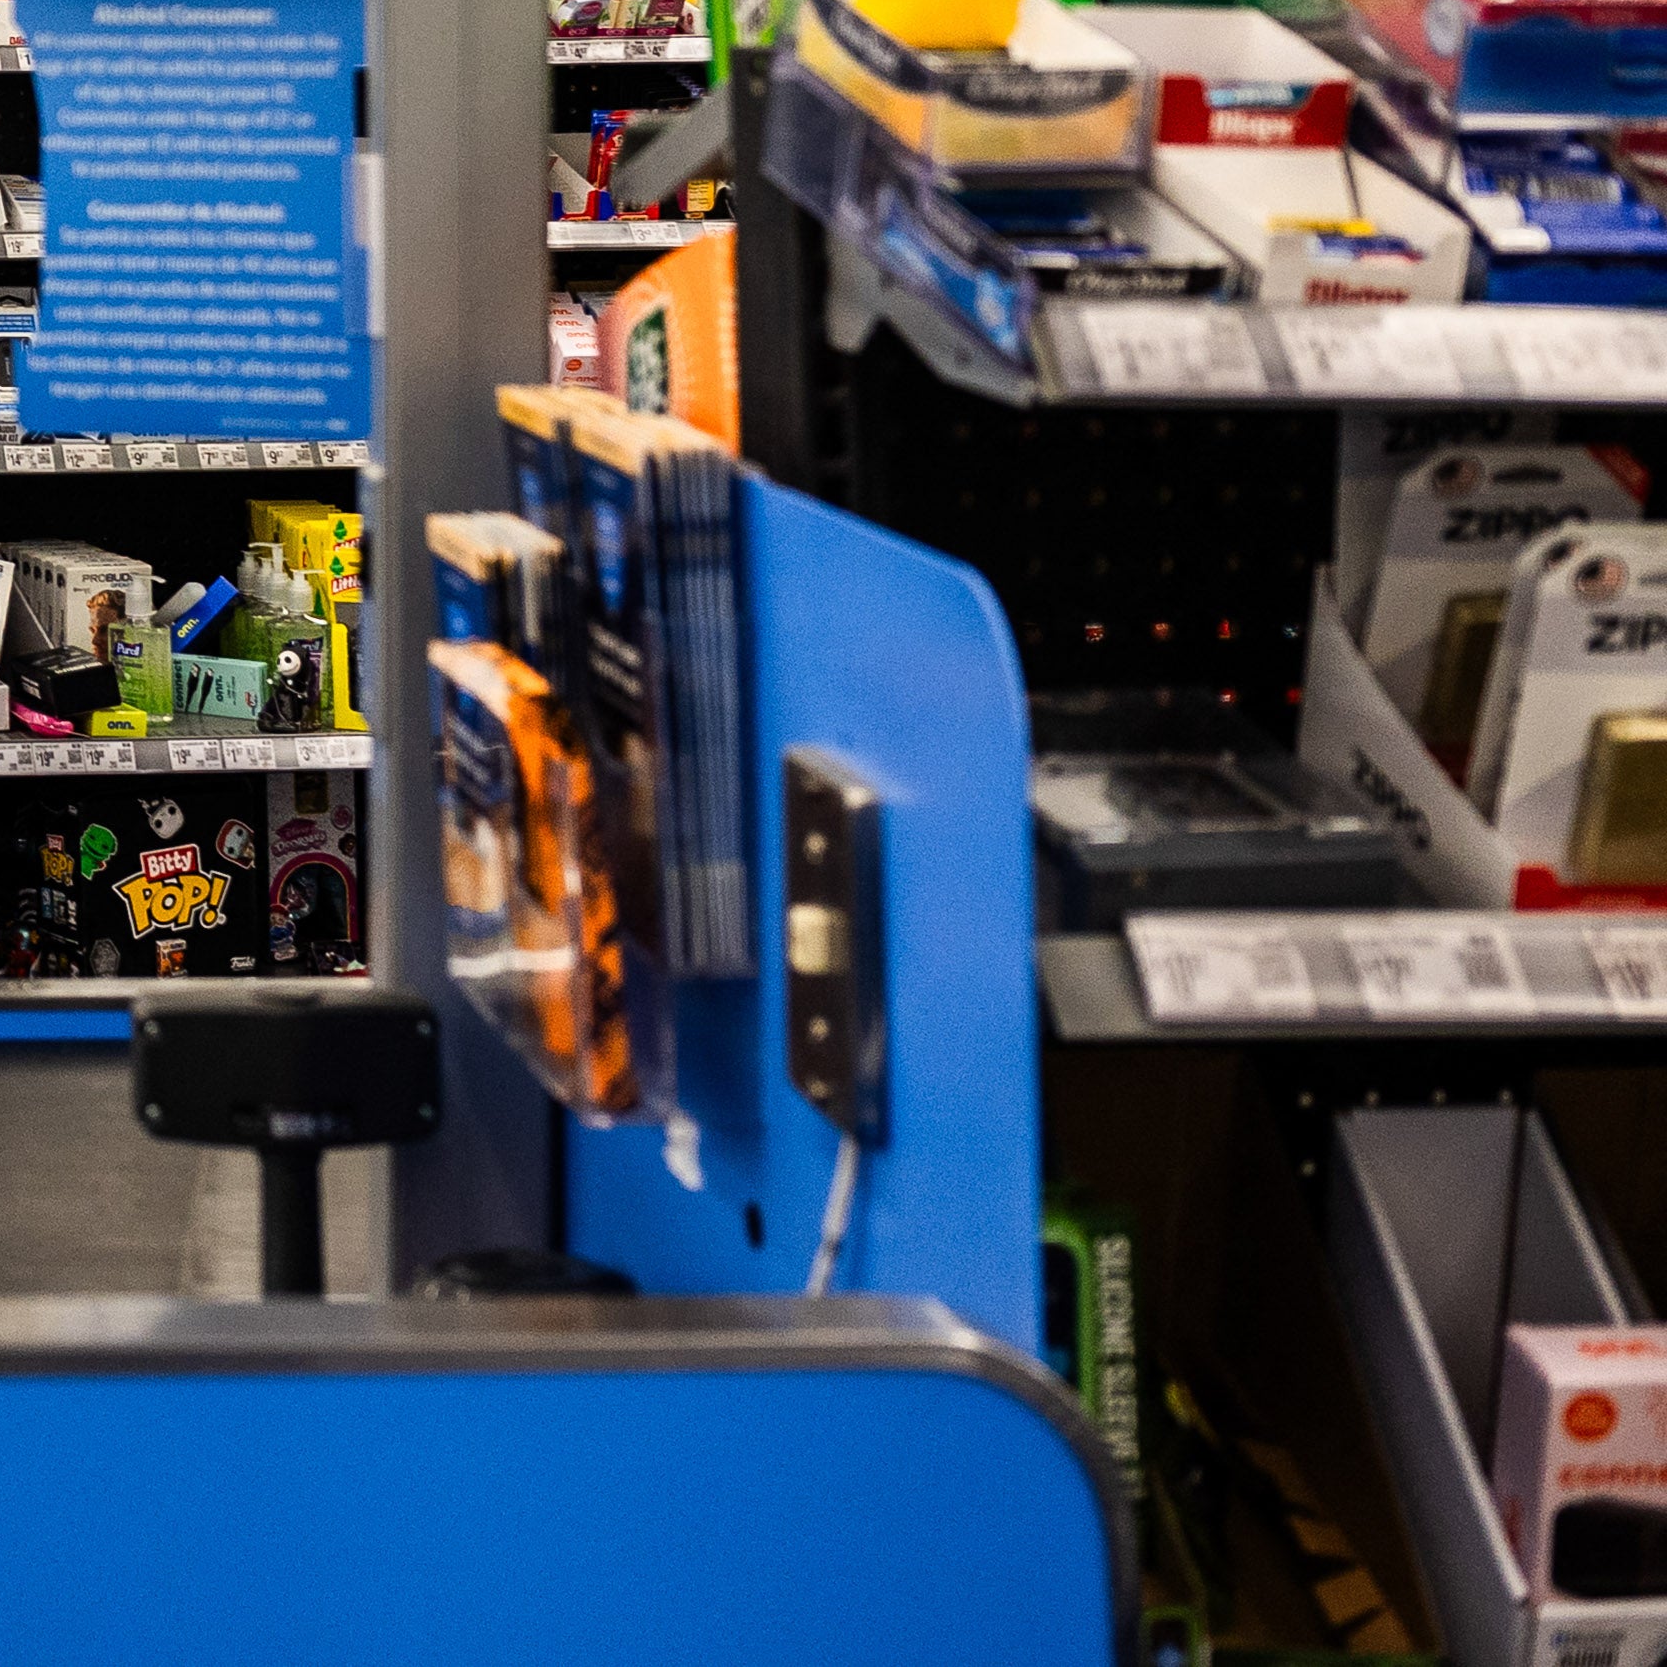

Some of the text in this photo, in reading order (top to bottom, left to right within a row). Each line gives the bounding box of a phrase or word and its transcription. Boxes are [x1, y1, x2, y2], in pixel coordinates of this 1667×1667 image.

[568, 27, 588, 37] eos
[606, 27, 628, 37] eos
[646, 27, 667, 37] eos
[177, 617, 200, 639] onn.
[118, 642, 141, 657] Purell
[216, 675, 224, 702] onn.
[107, 720, 135, 730] onn.
[147, 849, 193, 876] Bitty
[120, 873, 226, 932] POP!
